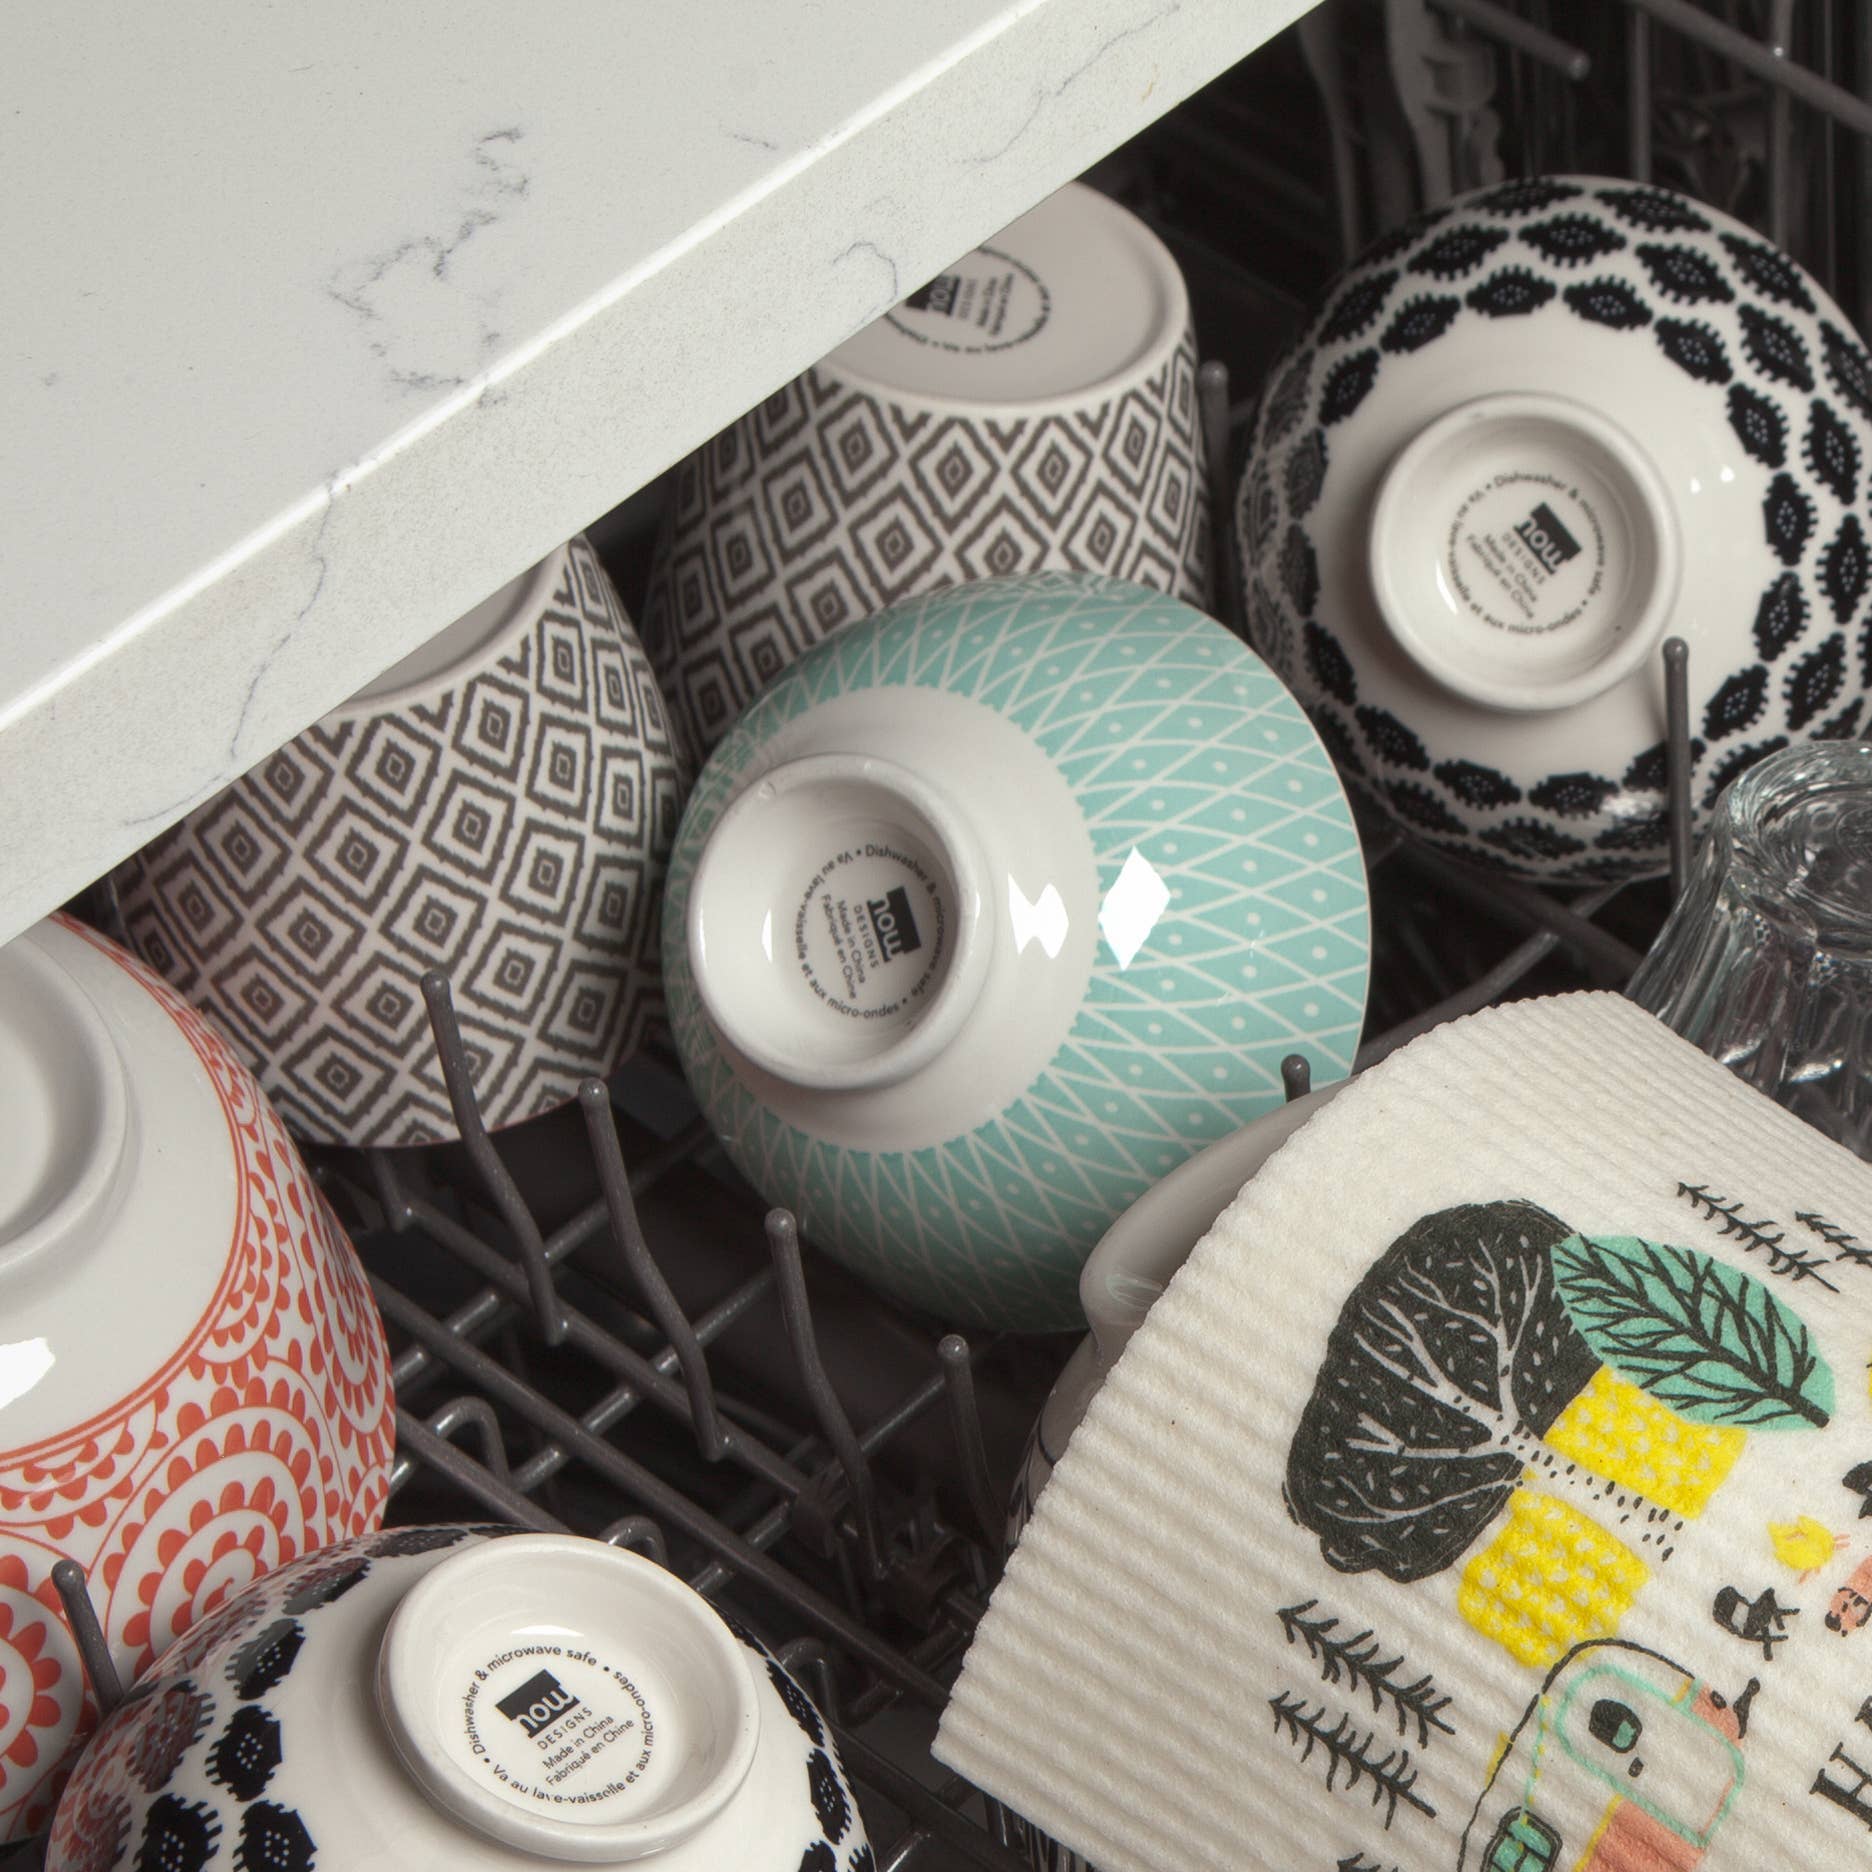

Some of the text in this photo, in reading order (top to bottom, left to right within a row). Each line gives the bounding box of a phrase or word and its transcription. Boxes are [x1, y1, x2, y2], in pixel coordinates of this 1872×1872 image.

[1513, 512, 1569, 573] now
[872, 894, 904, 959] now
[461, 1645, 597, 1756] Dishwasher & microwave safe
[511, 1687, 576, 1732] now
[613, 1671, 654, 1747] micro-ondes
[536, 1706, 593, 1751] DESIGNS
[541, 1715, 615, 1770] Made in China
[545, 1719, 635, 1786] Fabriqué en Chine
[493, 1763, 509, 1782] Va
[625, 1770, 640, 1784] et
[635, 1749, 652, 1772] aux
[510, 1780, 529, 1794] au
